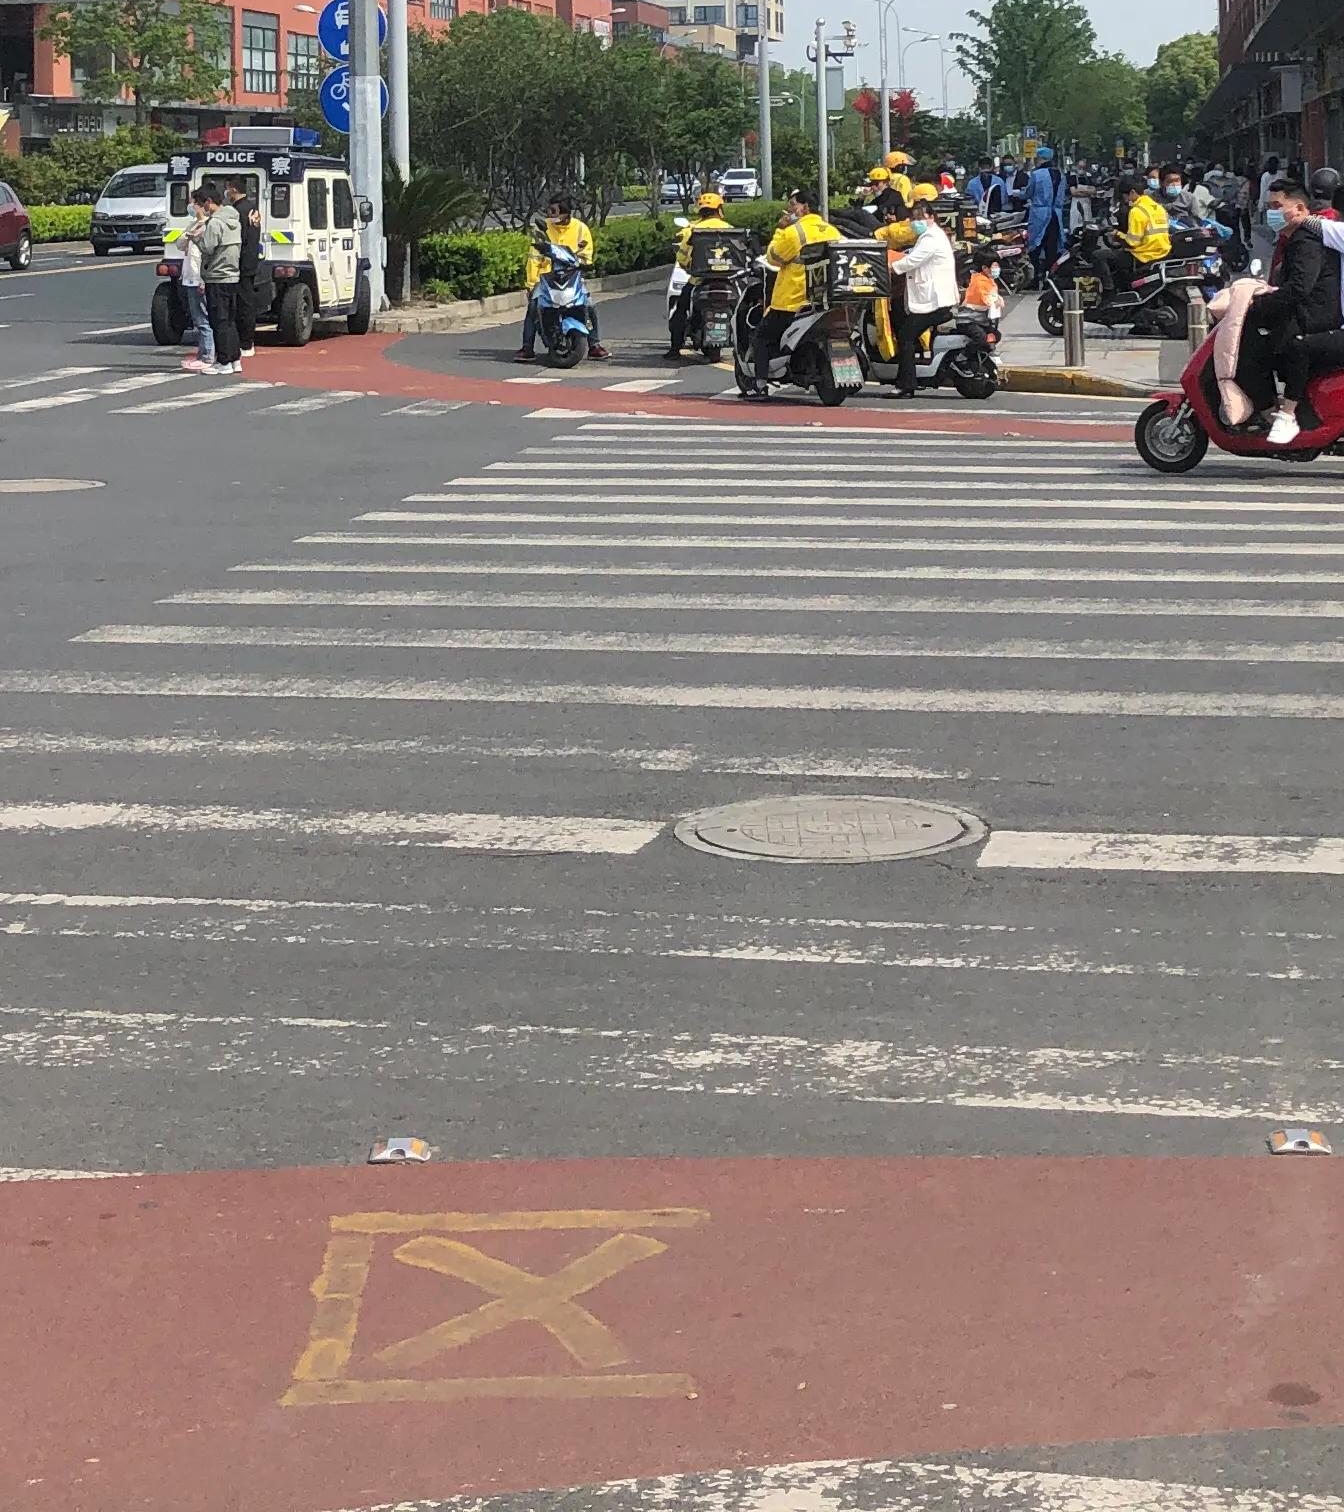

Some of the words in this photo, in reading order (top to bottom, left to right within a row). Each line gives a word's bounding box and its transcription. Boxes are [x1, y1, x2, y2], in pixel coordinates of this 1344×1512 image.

[170, 155, 191, 176] 警
[206, 151, 256, 163] POLICE
[271, 156, 291, 176] 察
